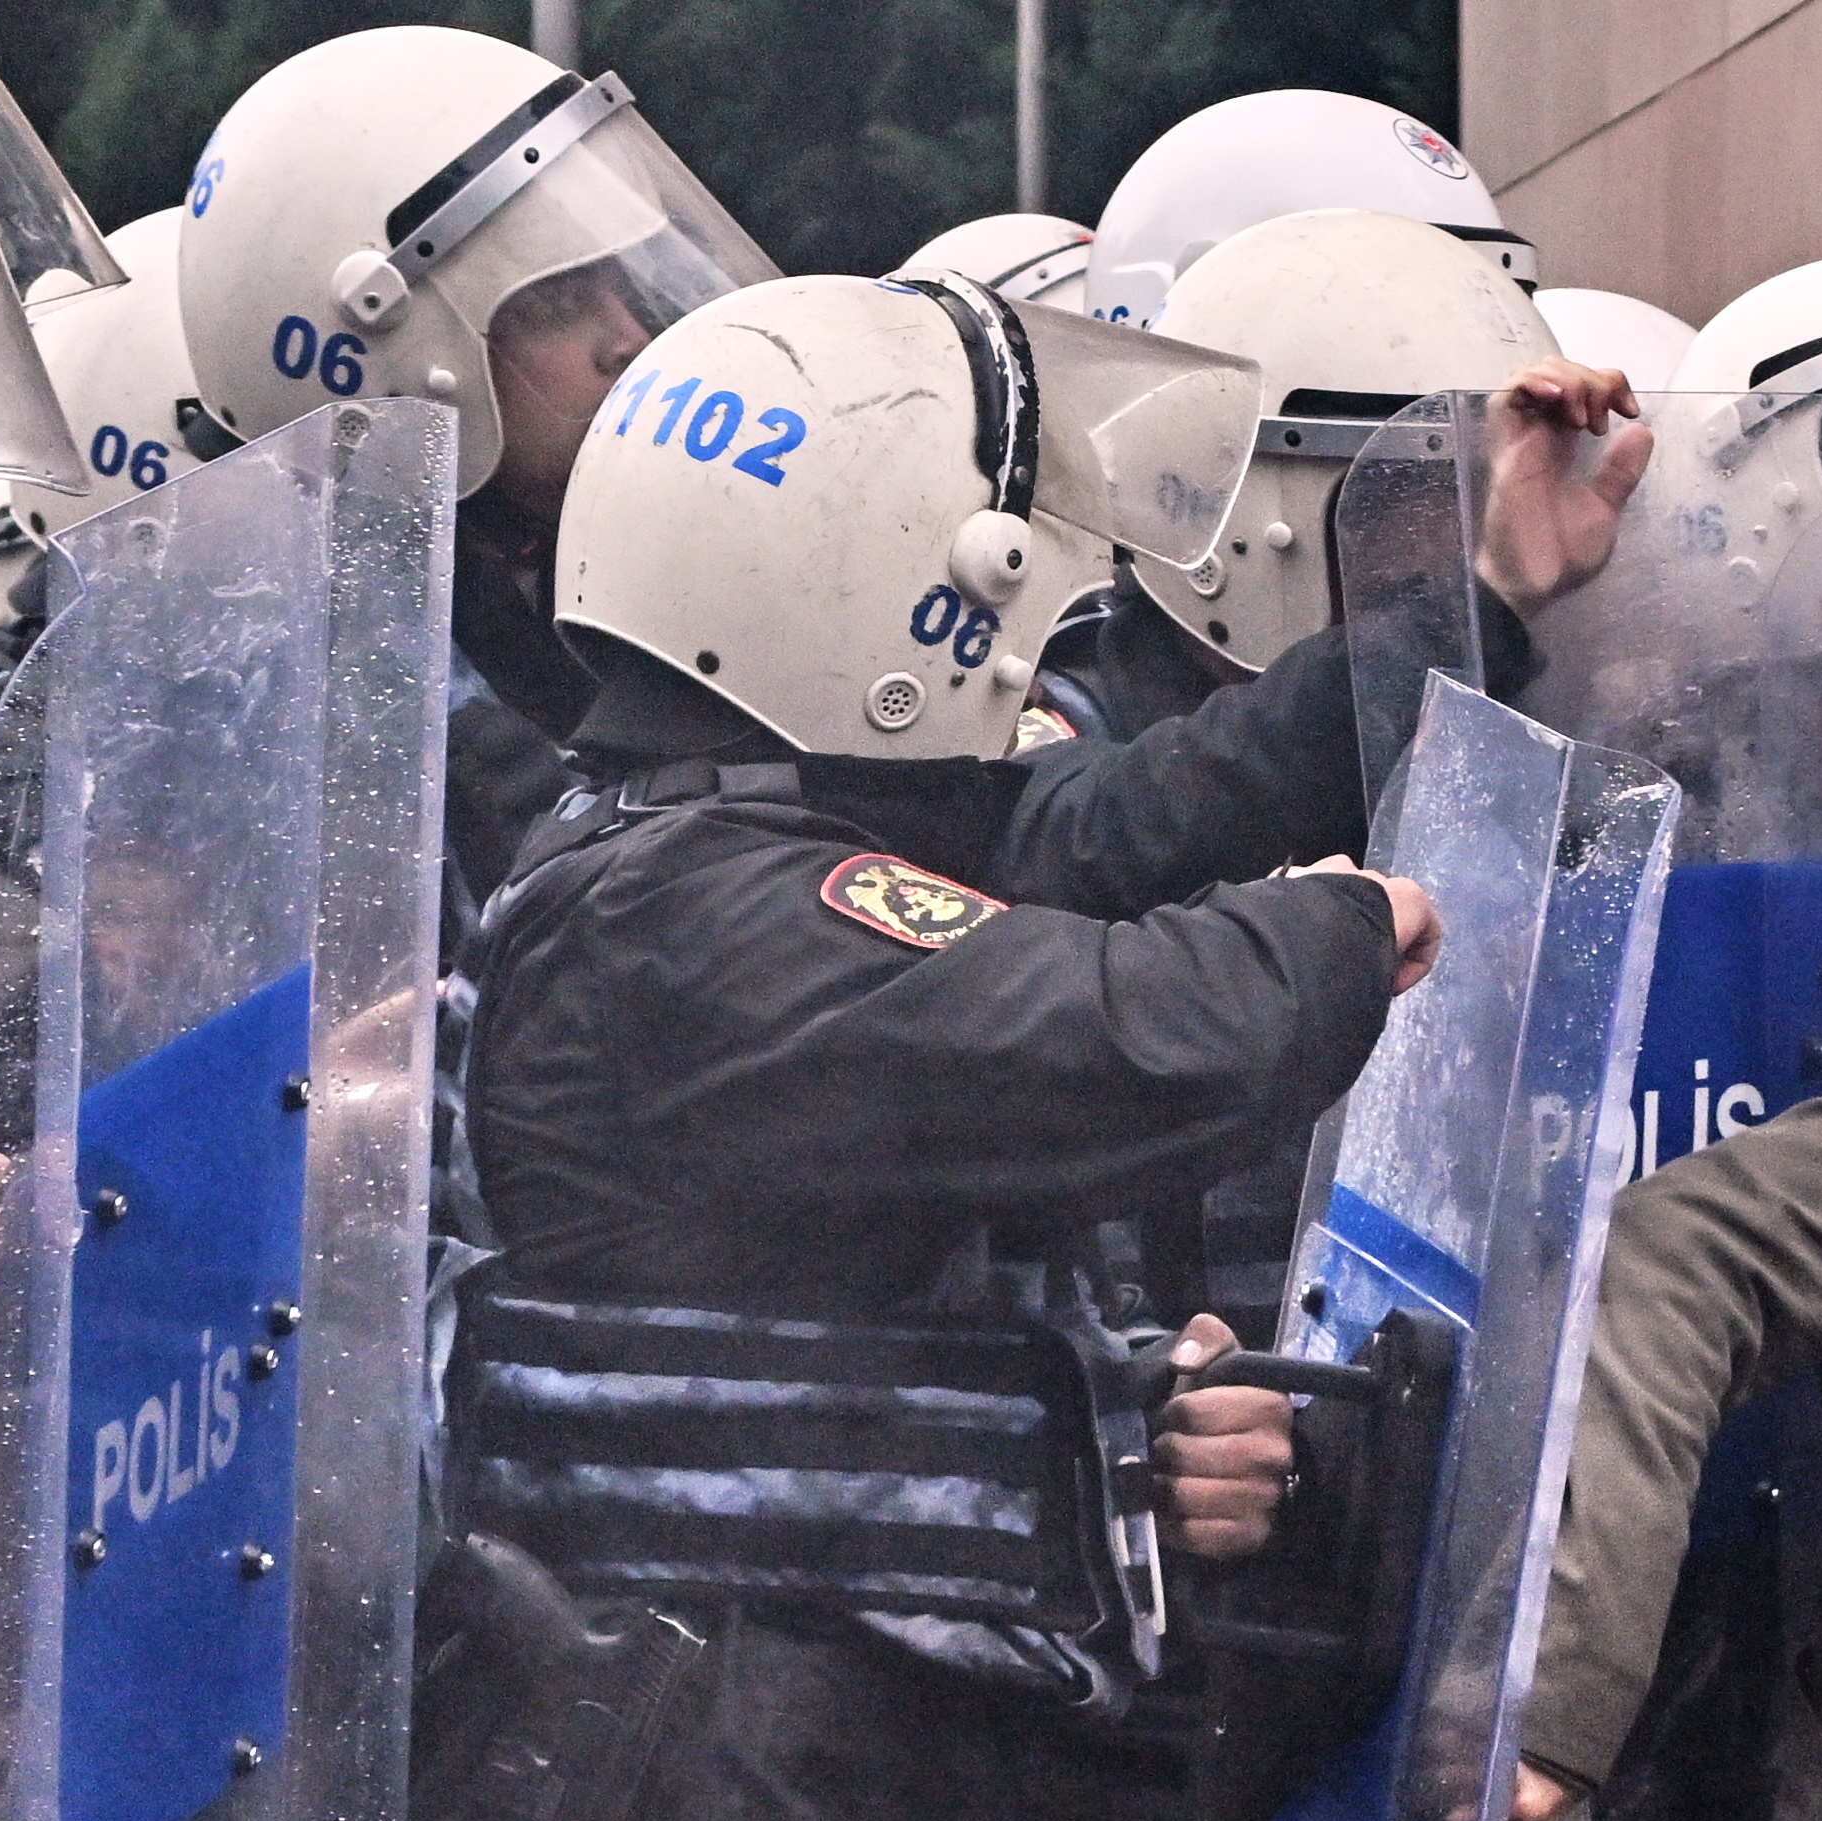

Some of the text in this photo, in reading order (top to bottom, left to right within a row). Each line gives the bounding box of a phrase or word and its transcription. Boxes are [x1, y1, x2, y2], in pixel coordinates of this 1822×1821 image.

[273, 314, 367, 397] 06
[90, 424, 170, 490] 06
[909, 583, 1002, 669] 06
[93, 1326, 241, 1532] POLİS
